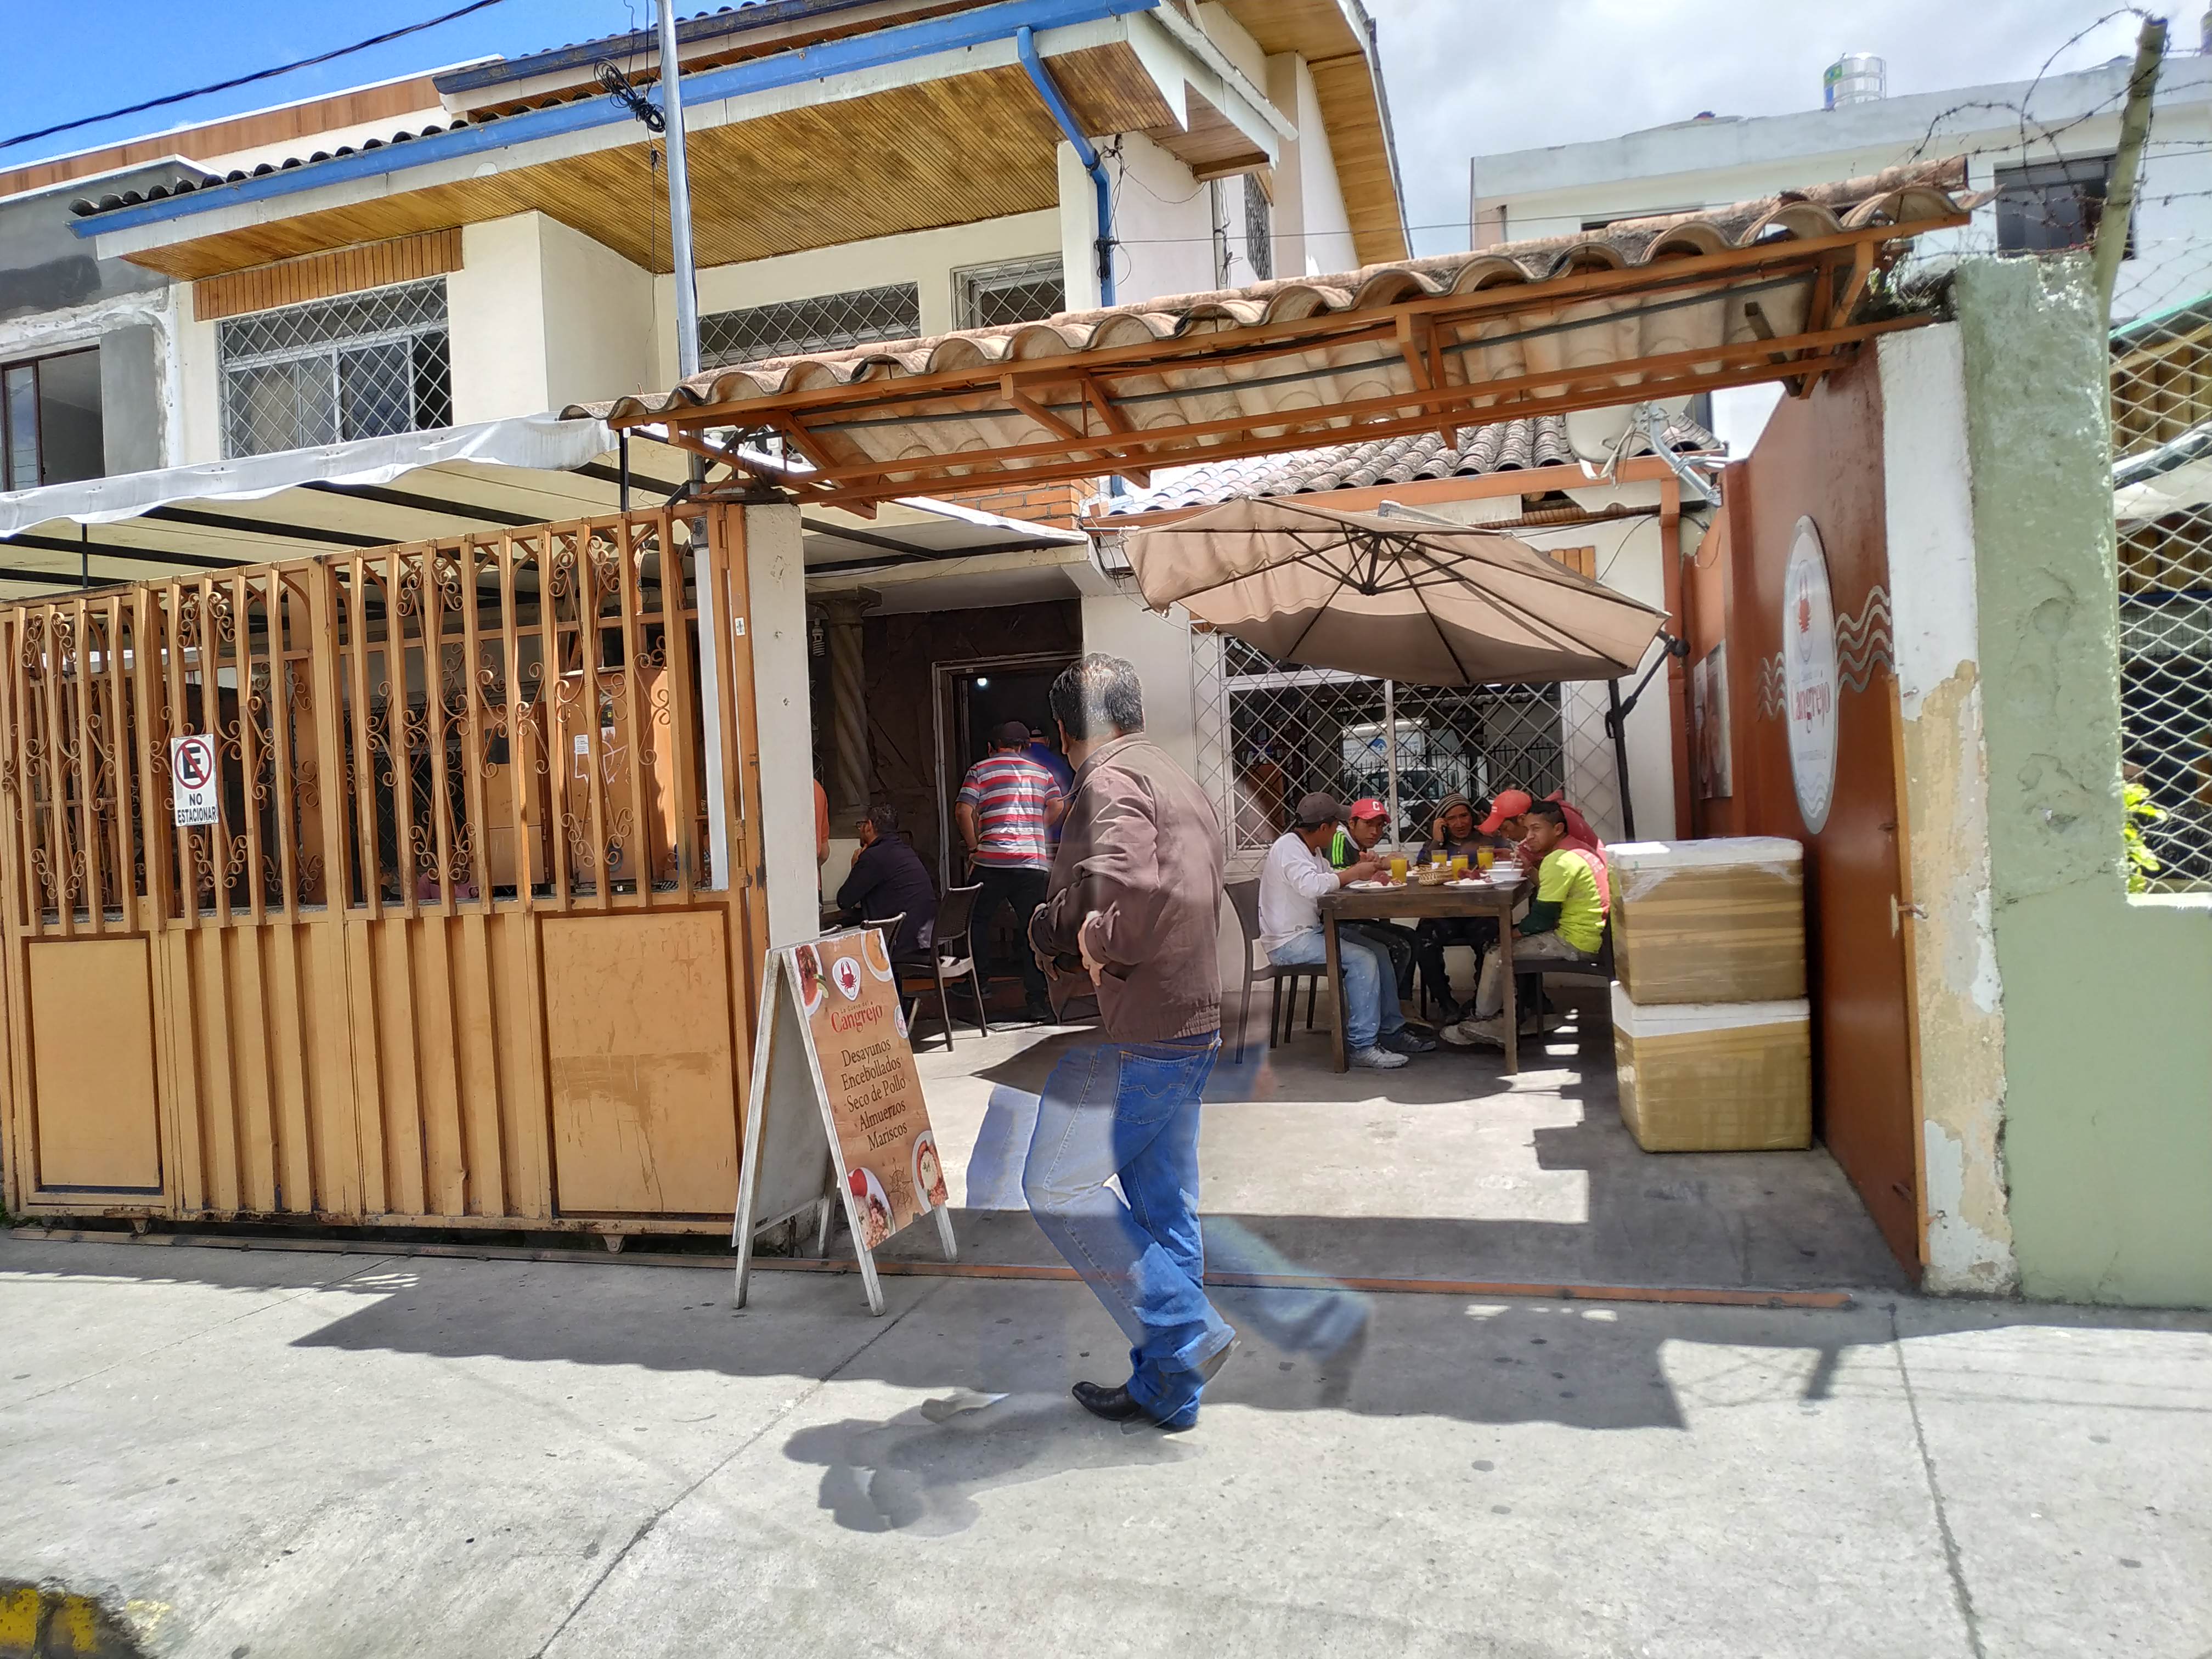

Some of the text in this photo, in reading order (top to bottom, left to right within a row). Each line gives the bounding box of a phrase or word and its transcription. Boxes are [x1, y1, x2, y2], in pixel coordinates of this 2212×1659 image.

[189, 793, 202, 806] NO
[1373, 801, 1380, 810] C
[177, 806, 217, 823] ESTACIONAR
[831, 1001, 883, 1032] Cangrejo
[841, 1039, 891, 1067] Desayunos
[841, 1055, 901, 1091] Encebollados
[847, 1074, 906, 1113] Seco de Pollo
[860, 1100, 906, 1132] Almuerzos
[867, 1122, 908, 1151] Mariscos
